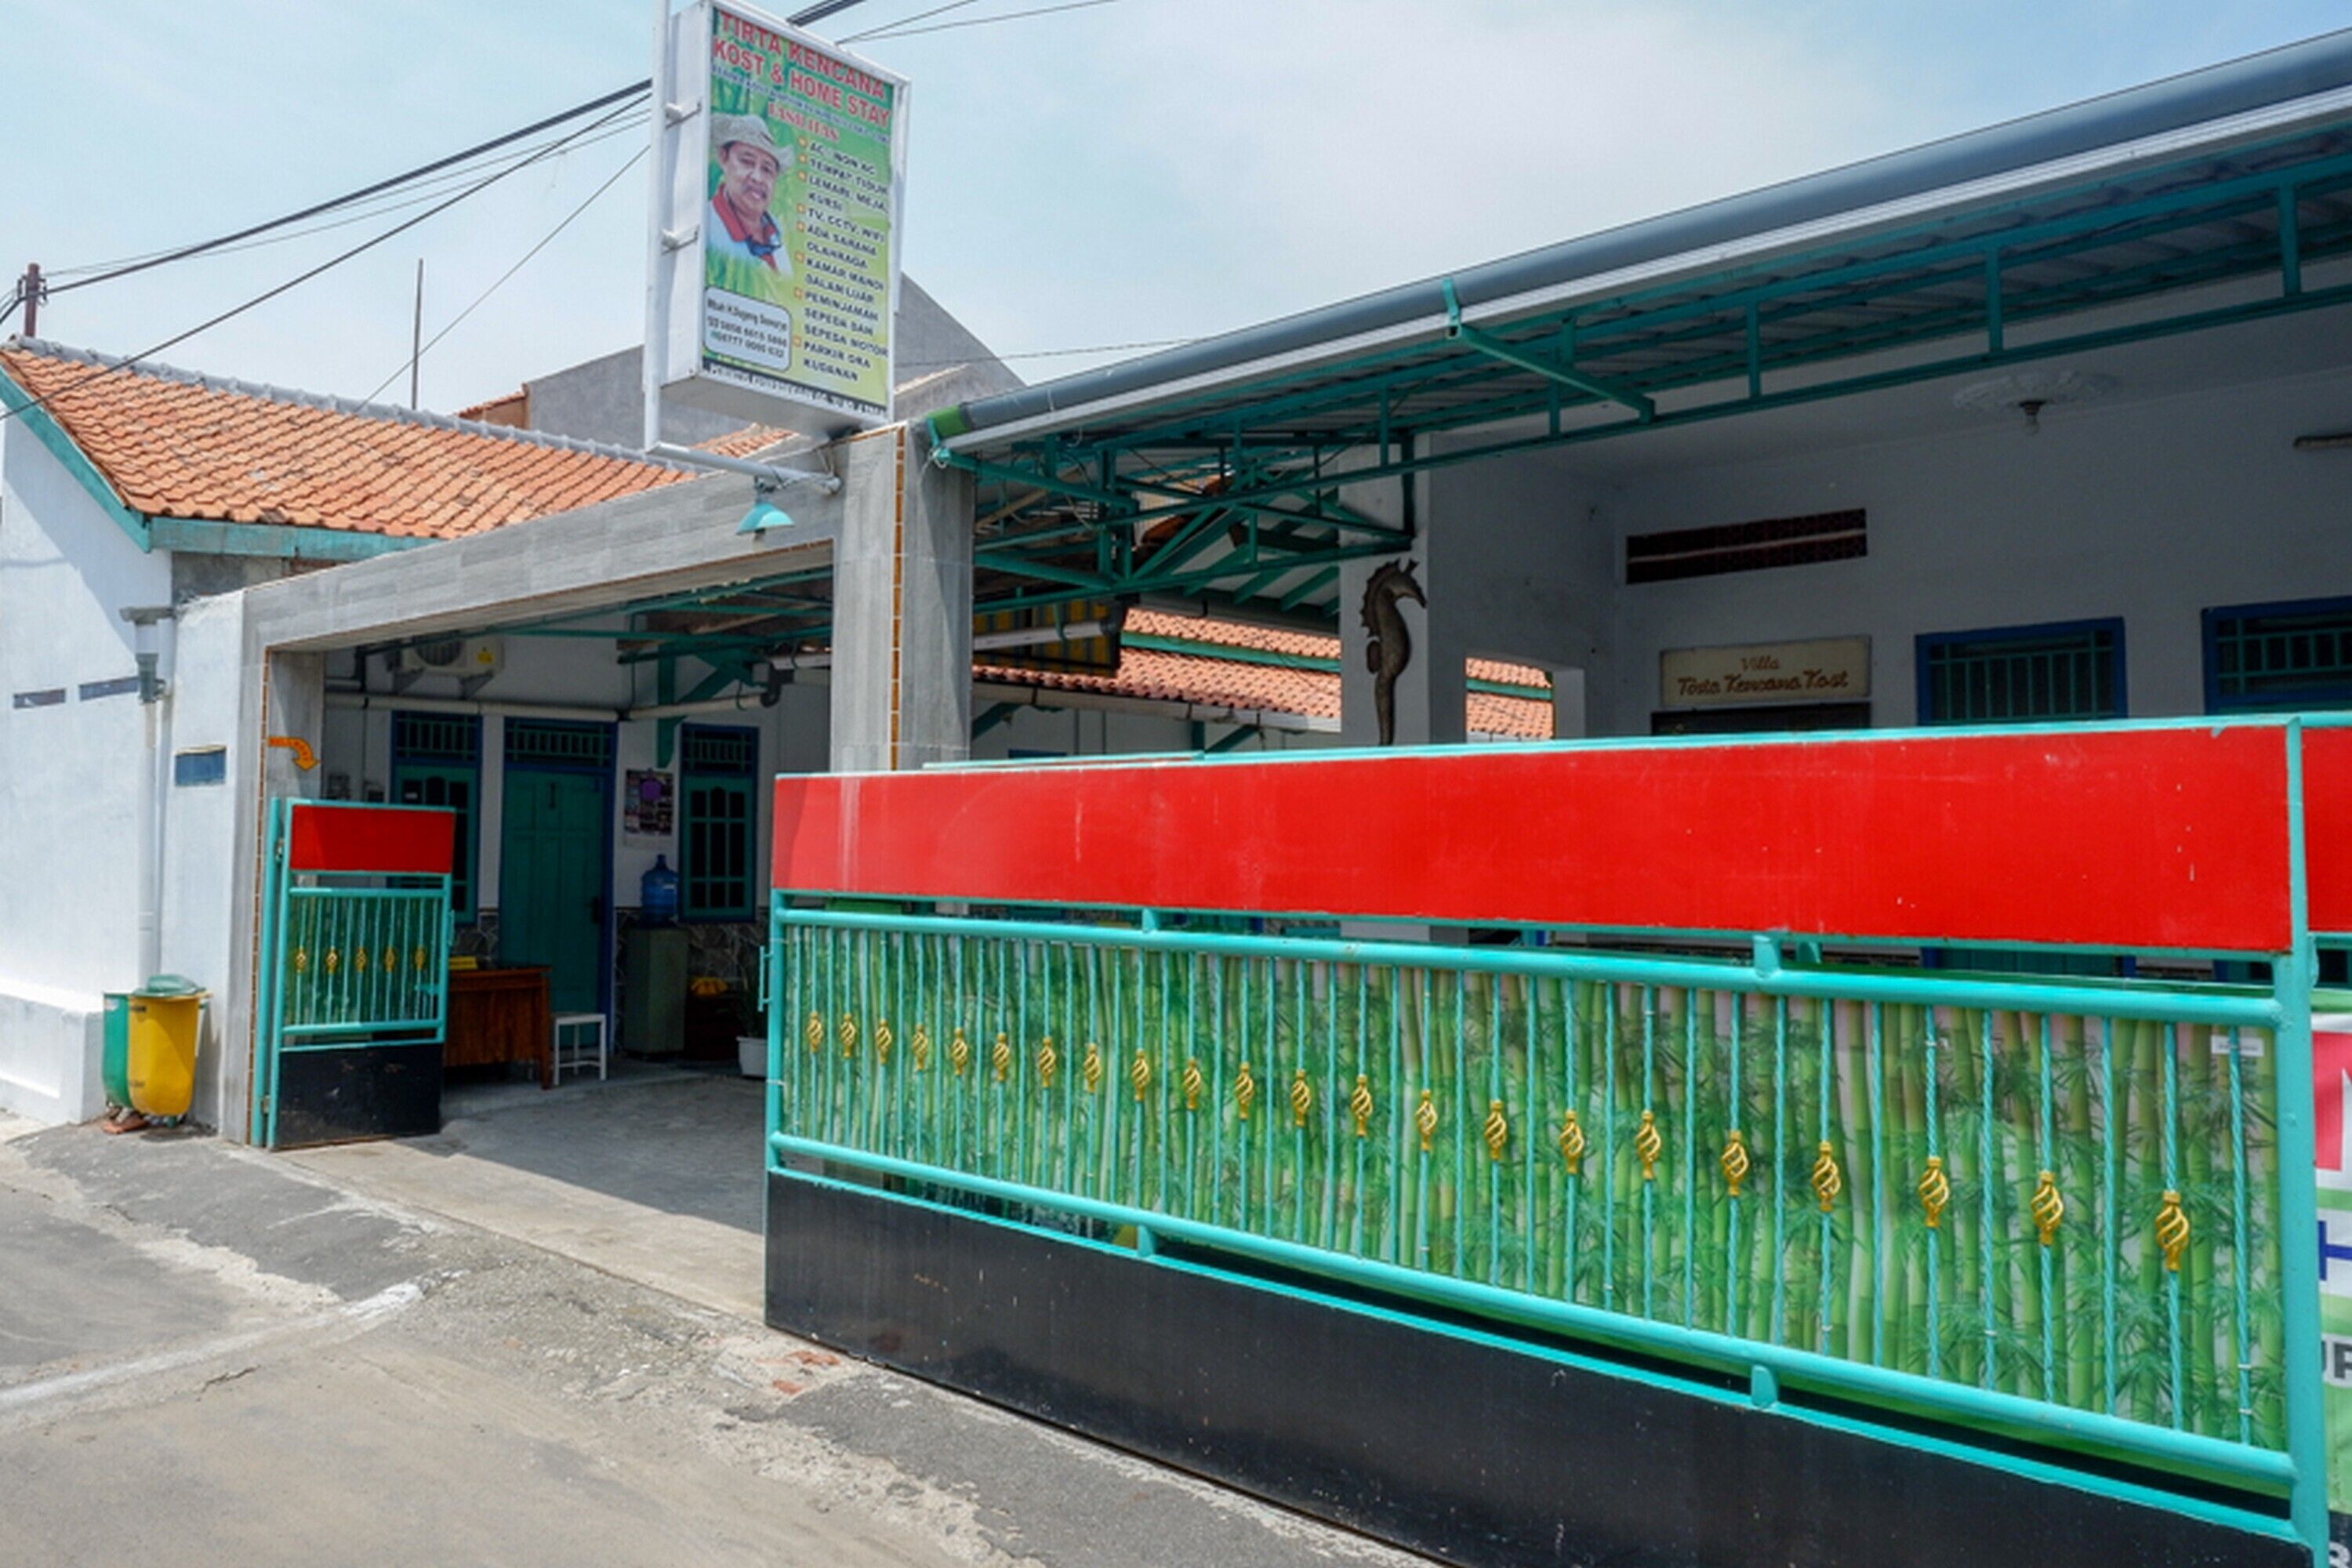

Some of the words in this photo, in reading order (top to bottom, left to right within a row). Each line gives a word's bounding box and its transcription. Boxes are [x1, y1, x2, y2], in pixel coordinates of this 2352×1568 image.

[719, 10, 782, 56] TIRTA
[788, 41, 885, 100] KENCANA
[713, 38, 764, 75] KOST
[770, 64, 782, 84] &
[790, 69, 842, 109] HOME
[848, 95, 891, 127] STAY
[768, 103, 838, 142] FASILITAS
[810, 158, 852, 179] TEMPAT
[856, 176, 887, 194] TIDUR
[834, 153, 858, 168] NON
[862, 164, 874, 175] AC
[809, 193, 842, 211] KURSI
[807, 241, 868, 269] OLAHRAGA
[808, 225, 830, 240] ADA
[833, 234, 876, 256] SARANA
[806, 274, 844, 296] DALAM
[807, 259, 847, 279] KAMAR
[848, 272, 884, 291] MANDI
[805, 291, 878, 321] PEMINJAMAN
[804, 307, 847, 328] SEPEDA
[851, 321, 873, 336] DAN
[804, 324, 847, 344] SEPEDA
[851, 339, 888, 358] MOTOR
[804, 341, 844, 360] PARKIR
[1740, 655, 1780, 671] Villa
